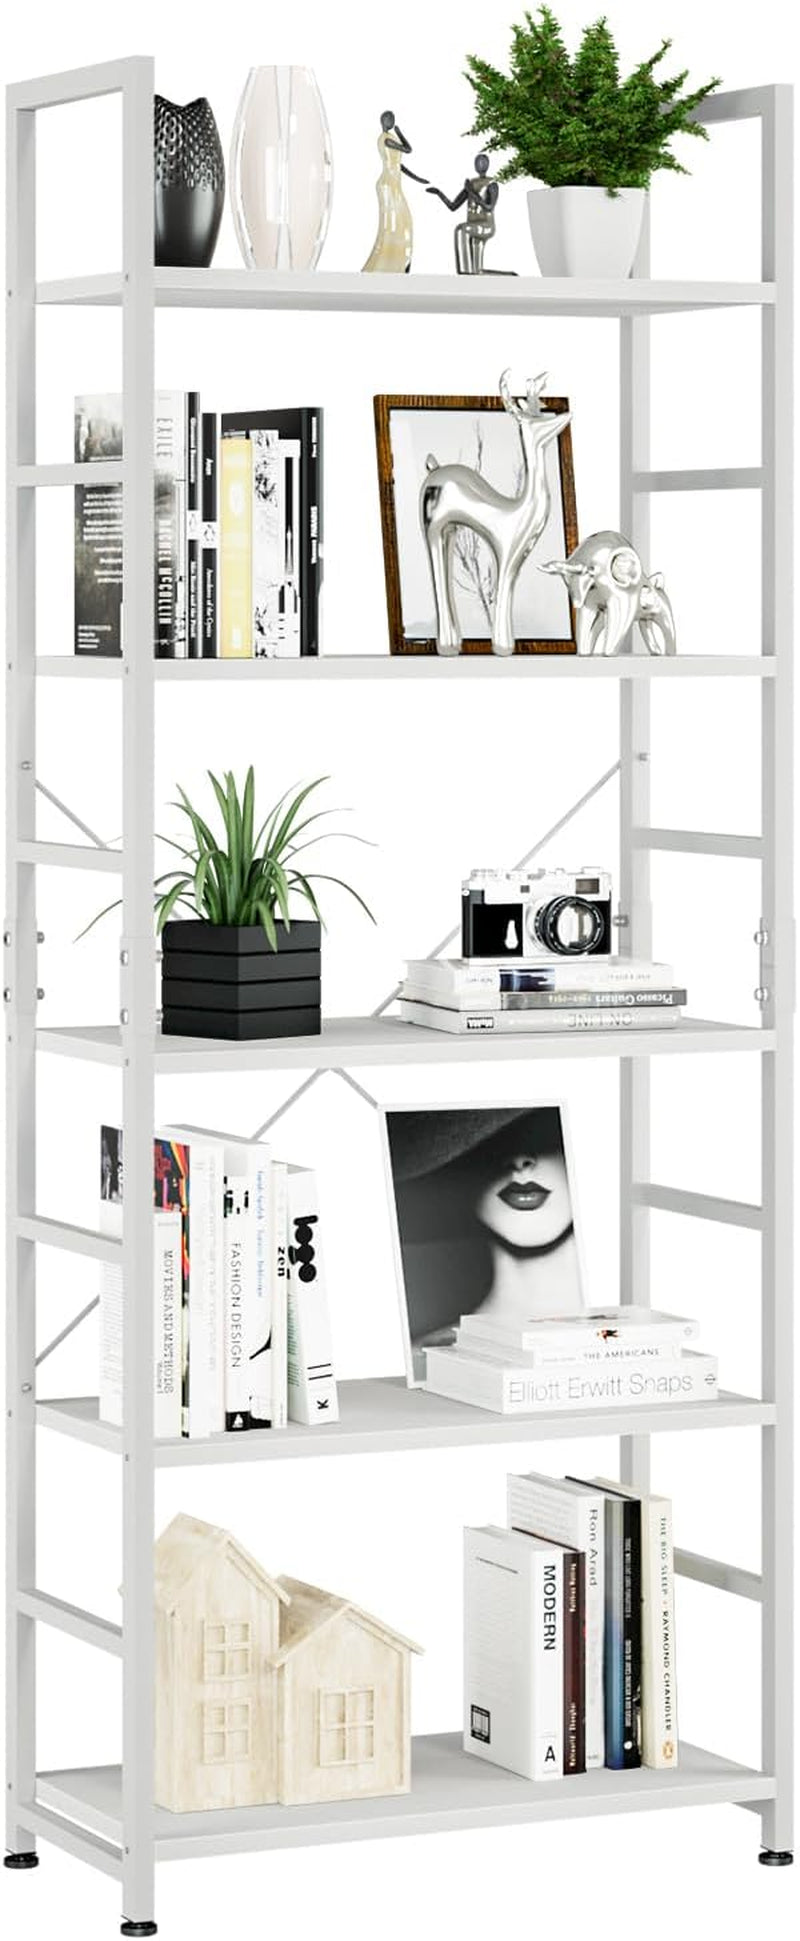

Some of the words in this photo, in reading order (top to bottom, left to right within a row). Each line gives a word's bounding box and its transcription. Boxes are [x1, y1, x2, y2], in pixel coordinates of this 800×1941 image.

[156, 418, 173, 457] EXILE
[595, 994, 635, 1005] Guitars
[635, 993, 674, 1005] Picasso
[277, 1246, 286, 1277] zen
[288, 1215, 319, 1283] logo
[163, 1250, 174, 1301] MOVIES
[230, 1242, 242, 1307] FASHION
[163, 1304, 174, 1331] AND
[230, 1313, 242, 1368] DESIGN
[584, 1351, 600, 1360] THE
[604, 1348, 659, 1359] AMERICANS
[163, 1333, 175, 1394] METHODS
[509, 1379, 561, 1403] Elliott
[568, 1375, 622, 1400] Erwitt
[629, 1373, 693, 1397] Snaps
[589, 1508, 598, 1543] Ron
[589, 1549, 598, 1587] Arad
[660, 1566, 668, 1596] SLEEP
[543, 1564, 557, 1651] MODERN
[662, 1610, 670, 1668] RAYMOND
[663, 1672, 672, 1731] CHANDLER
[544, 1745, 556, 1763] A
